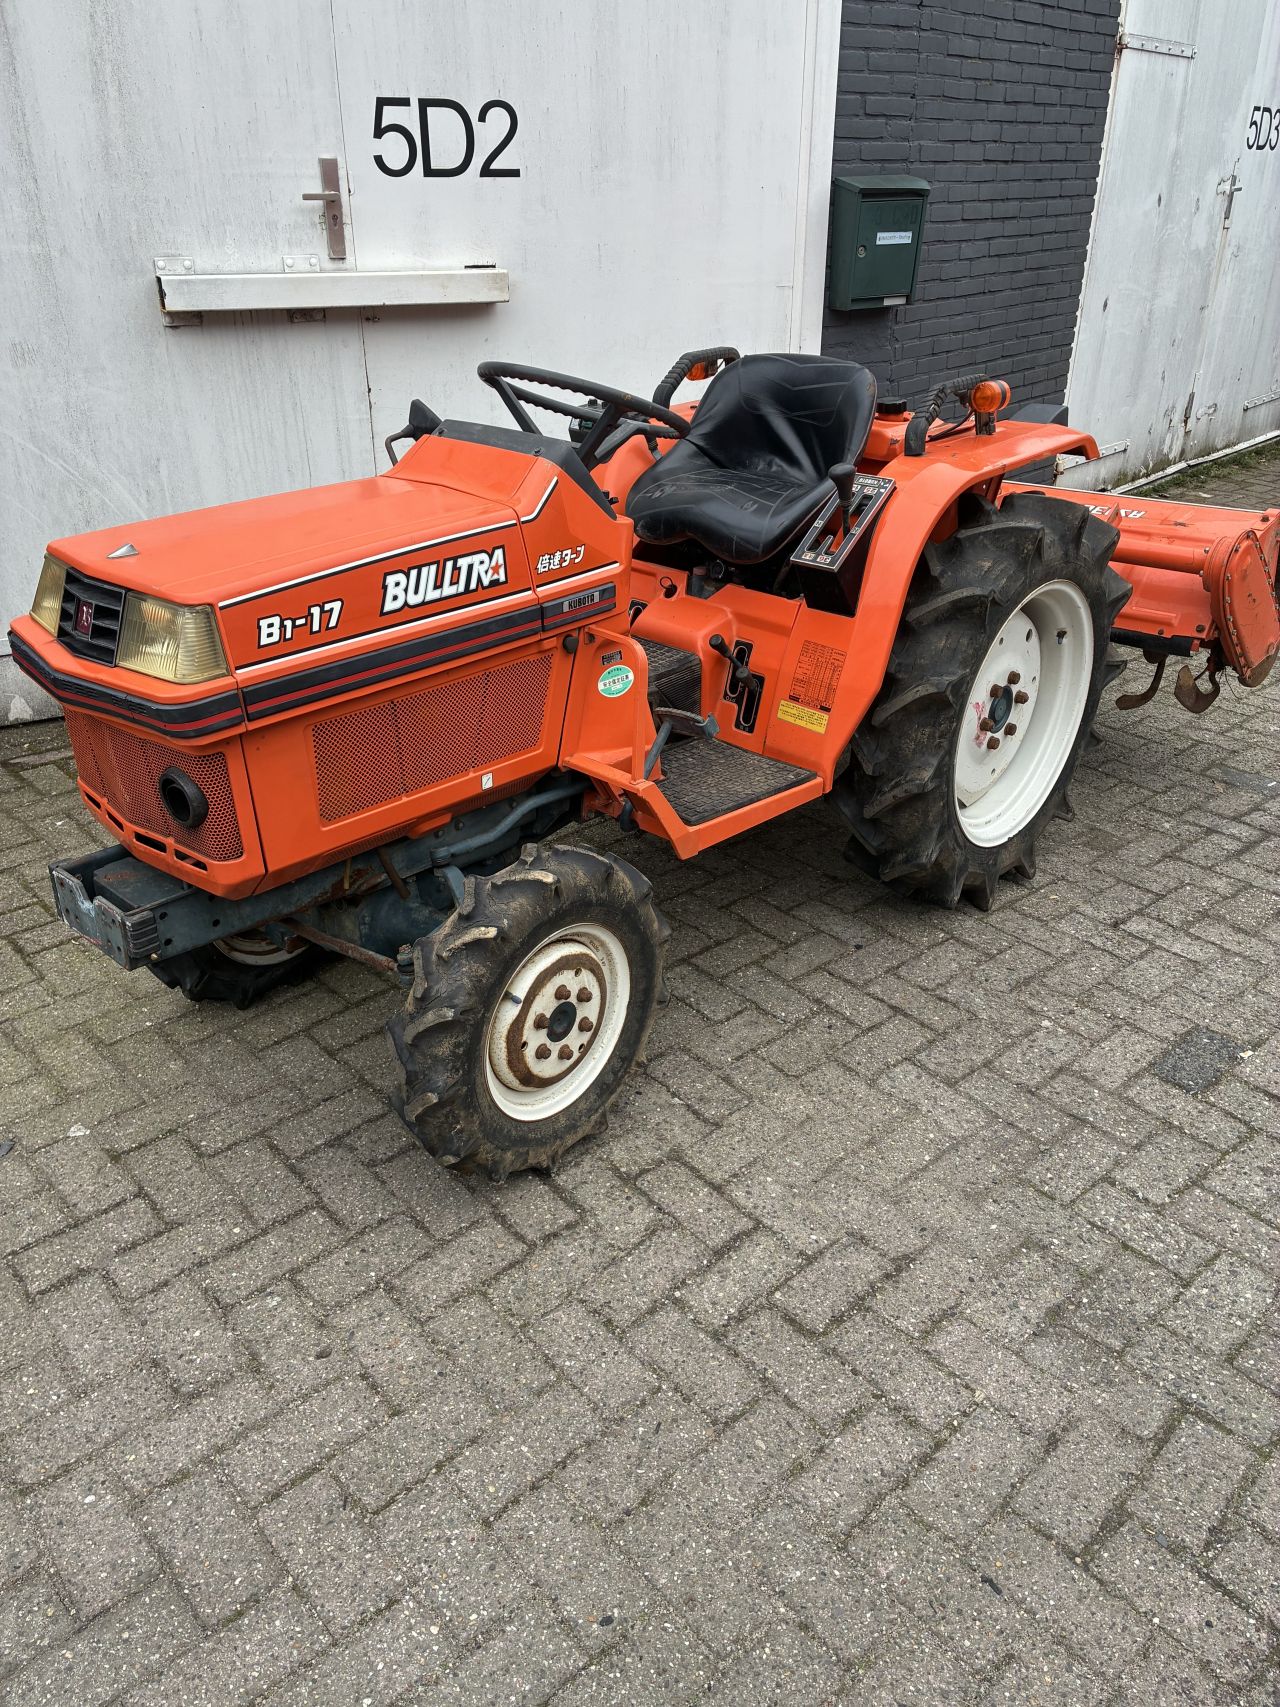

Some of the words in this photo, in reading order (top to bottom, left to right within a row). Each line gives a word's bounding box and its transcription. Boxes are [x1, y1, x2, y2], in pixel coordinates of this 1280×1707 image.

[373, 97, 521, 177] 5D2
[1246, 106, 1280, 151] 5D3
[380, 546, 507, 616] BULLTRA
[537, 544, 585, 574] 倍速ターン
[258, 599, 343, 648] B1-17
[568, 593, 596, 610] KUBOTA
